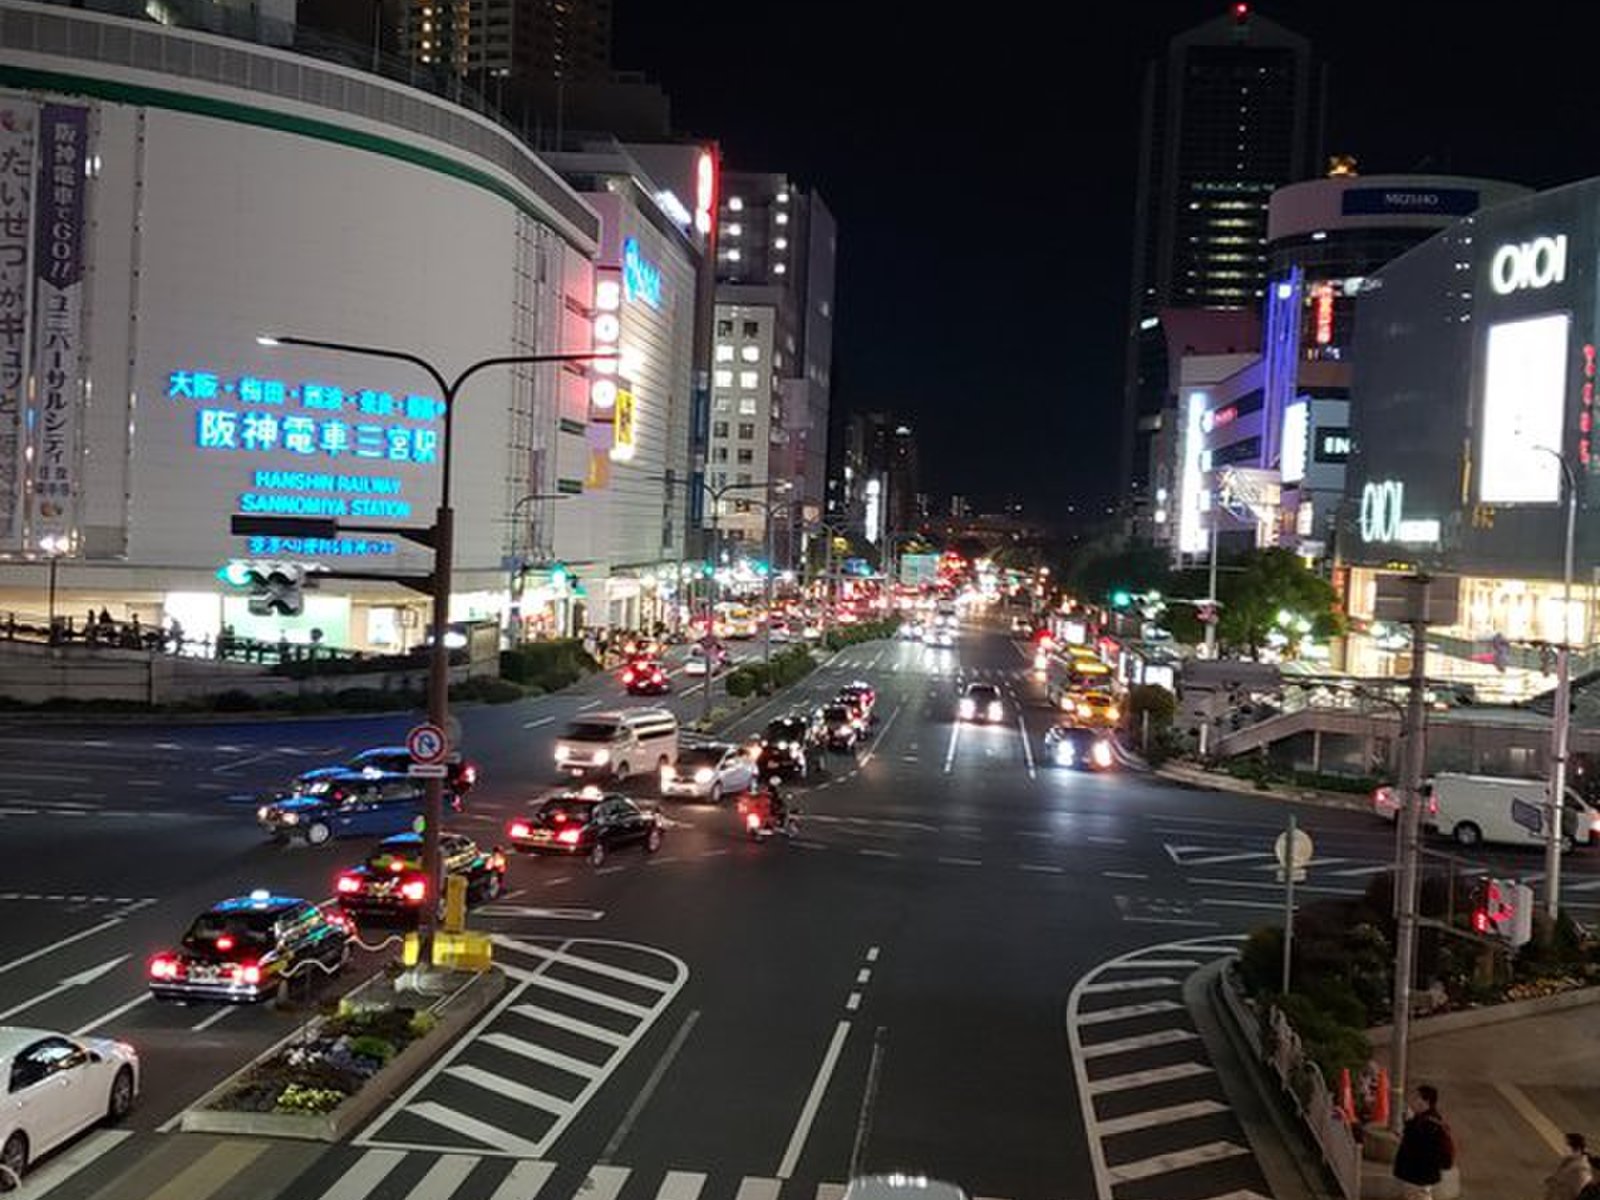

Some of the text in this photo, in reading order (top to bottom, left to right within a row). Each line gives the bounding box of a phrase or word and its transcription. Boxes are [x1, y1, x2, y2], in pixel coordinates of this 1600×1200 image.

[198, 408, 437, 464] 阪神電車三宮駅
[255, 471, 402, 495] HANSHIN RAILWAY
[240, 493, 412, 517] SANNOMIYA STATION
